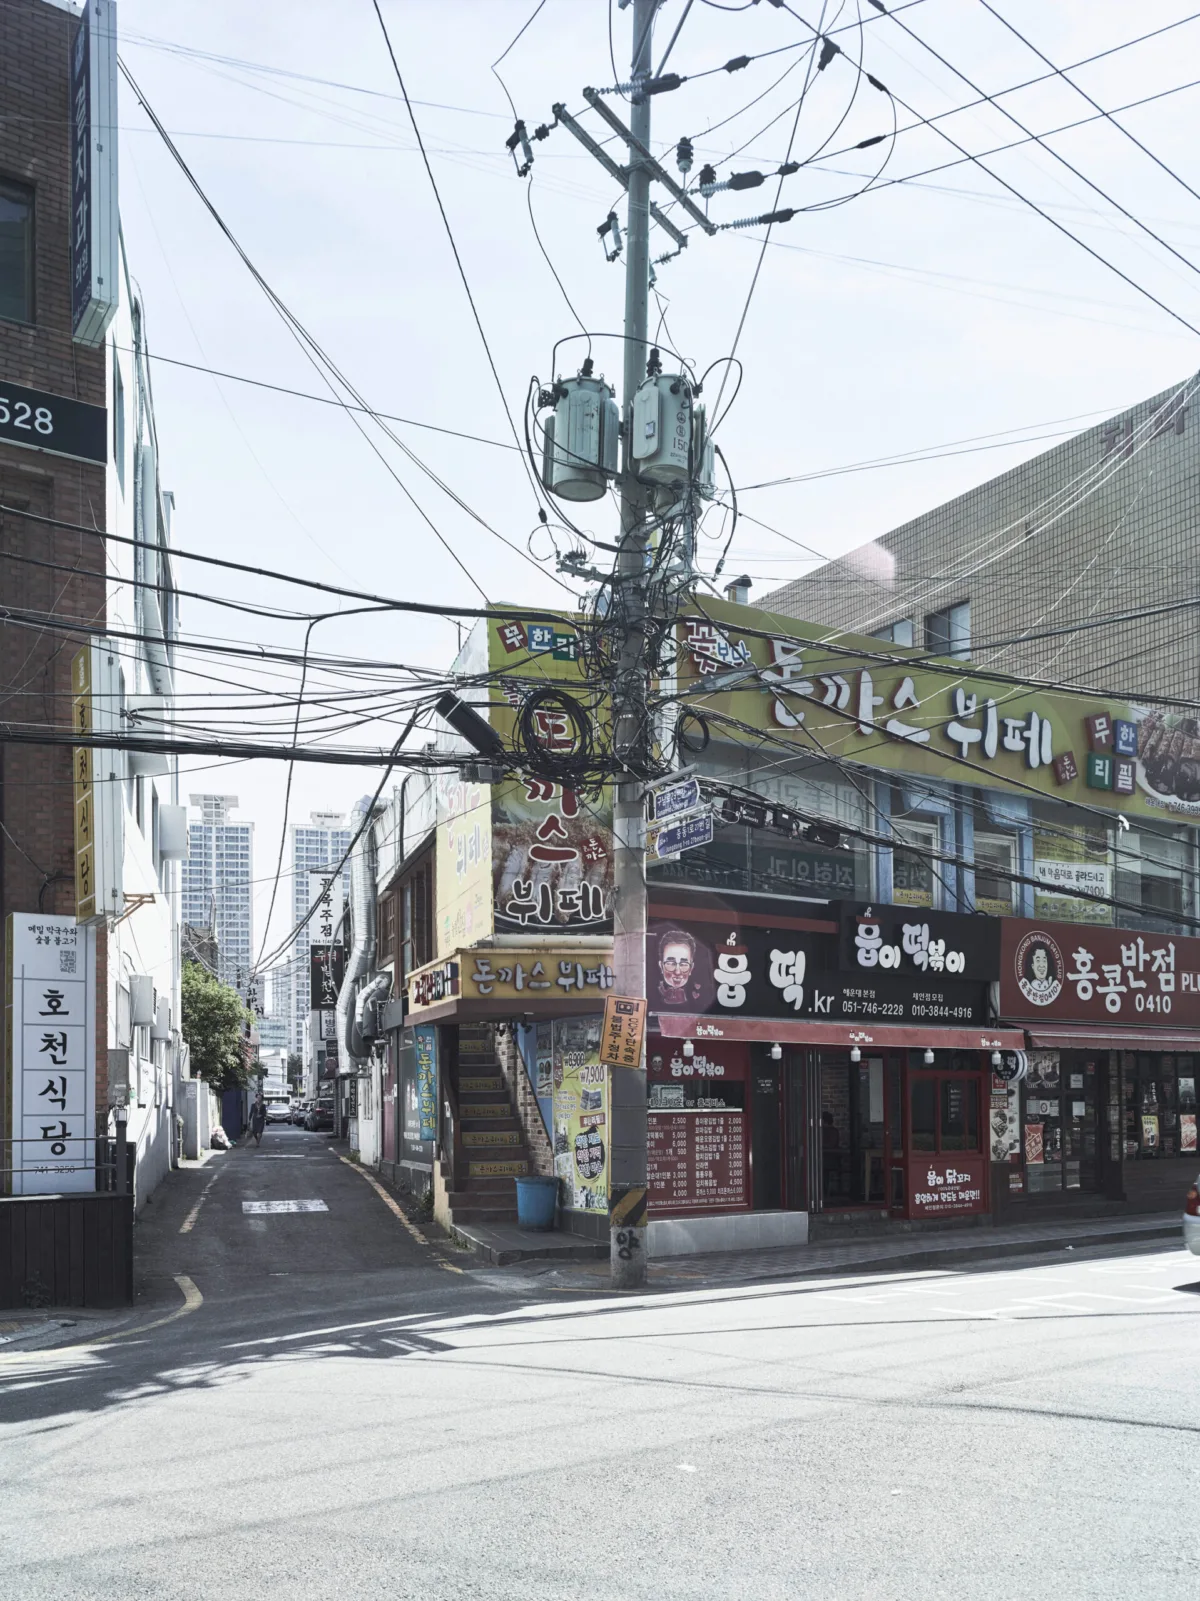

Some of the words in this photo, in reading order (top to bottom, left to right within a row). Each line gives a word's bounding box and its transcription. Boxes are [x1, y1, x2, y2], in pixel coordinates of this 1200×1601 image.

[760, 638, 930, 747] 돈까스
[944, 686, 1053, 769] 뷔페
[1095, 717, 1135, 752] 무한
[1095, 759, 1133, 790] 리필
[1039, 867, 1046, 877] 내
[1048, 868, 1073, 880] 마음대로
[1074, 871, 1104, 882] 골라드시고
[506, 880, 605, 927] 뷔페
[28, 925, 44, 934] 메밀
[46, 925, 78, 936] 막국수와
[54, 937, 77, 946] 불고기
[902, 923, 966, 973] 떡볶이
[1018, 938, 1031, 977] HONGKONG
[1030, 934, 1051, 947] BANJUM
[472, 958, 551, 994] 돈까스
[556, 960, 614, 993] 뷔페
[1066, 936, 1175, 1013] 홍콩반점
[843, 988, 861, 998] 해운대
[863, 989, 876, 998] 본점
[912, 992, 931, 1001] 체인점
[932, 993, 944, 1002] 모집
[842, 1001, 904, 1015] 051-746-2228
[1135, 993, 1172, 1014] 0410
[912, 1005, 972, 1018] 010-3844-4916
[39, 989, 72, 1156] 호천식당
[693, 1056, 725, 1077] 떡볶이
[672, 1117, 687, 1125] 2,500
[728, 1117, 742, 1125] 2,000
[672, 1131, 687, 1139] 5,000
[728, 1126, 742, 1134] 2,000
[576, 1135, 588, 1148] 착한
[728, 1143, 742, 1151] 3,000
[577, 1149, 590, 1164] 착한
[590, 1146, 602, 1160] 가격
[578, 1163, 591, 1178] 착한
[673, 1189, 687, 1197] 4,000
[940, 1191, 957, 1202] 만드는
[958, 1189, 980, 1201] 매운맛!!
